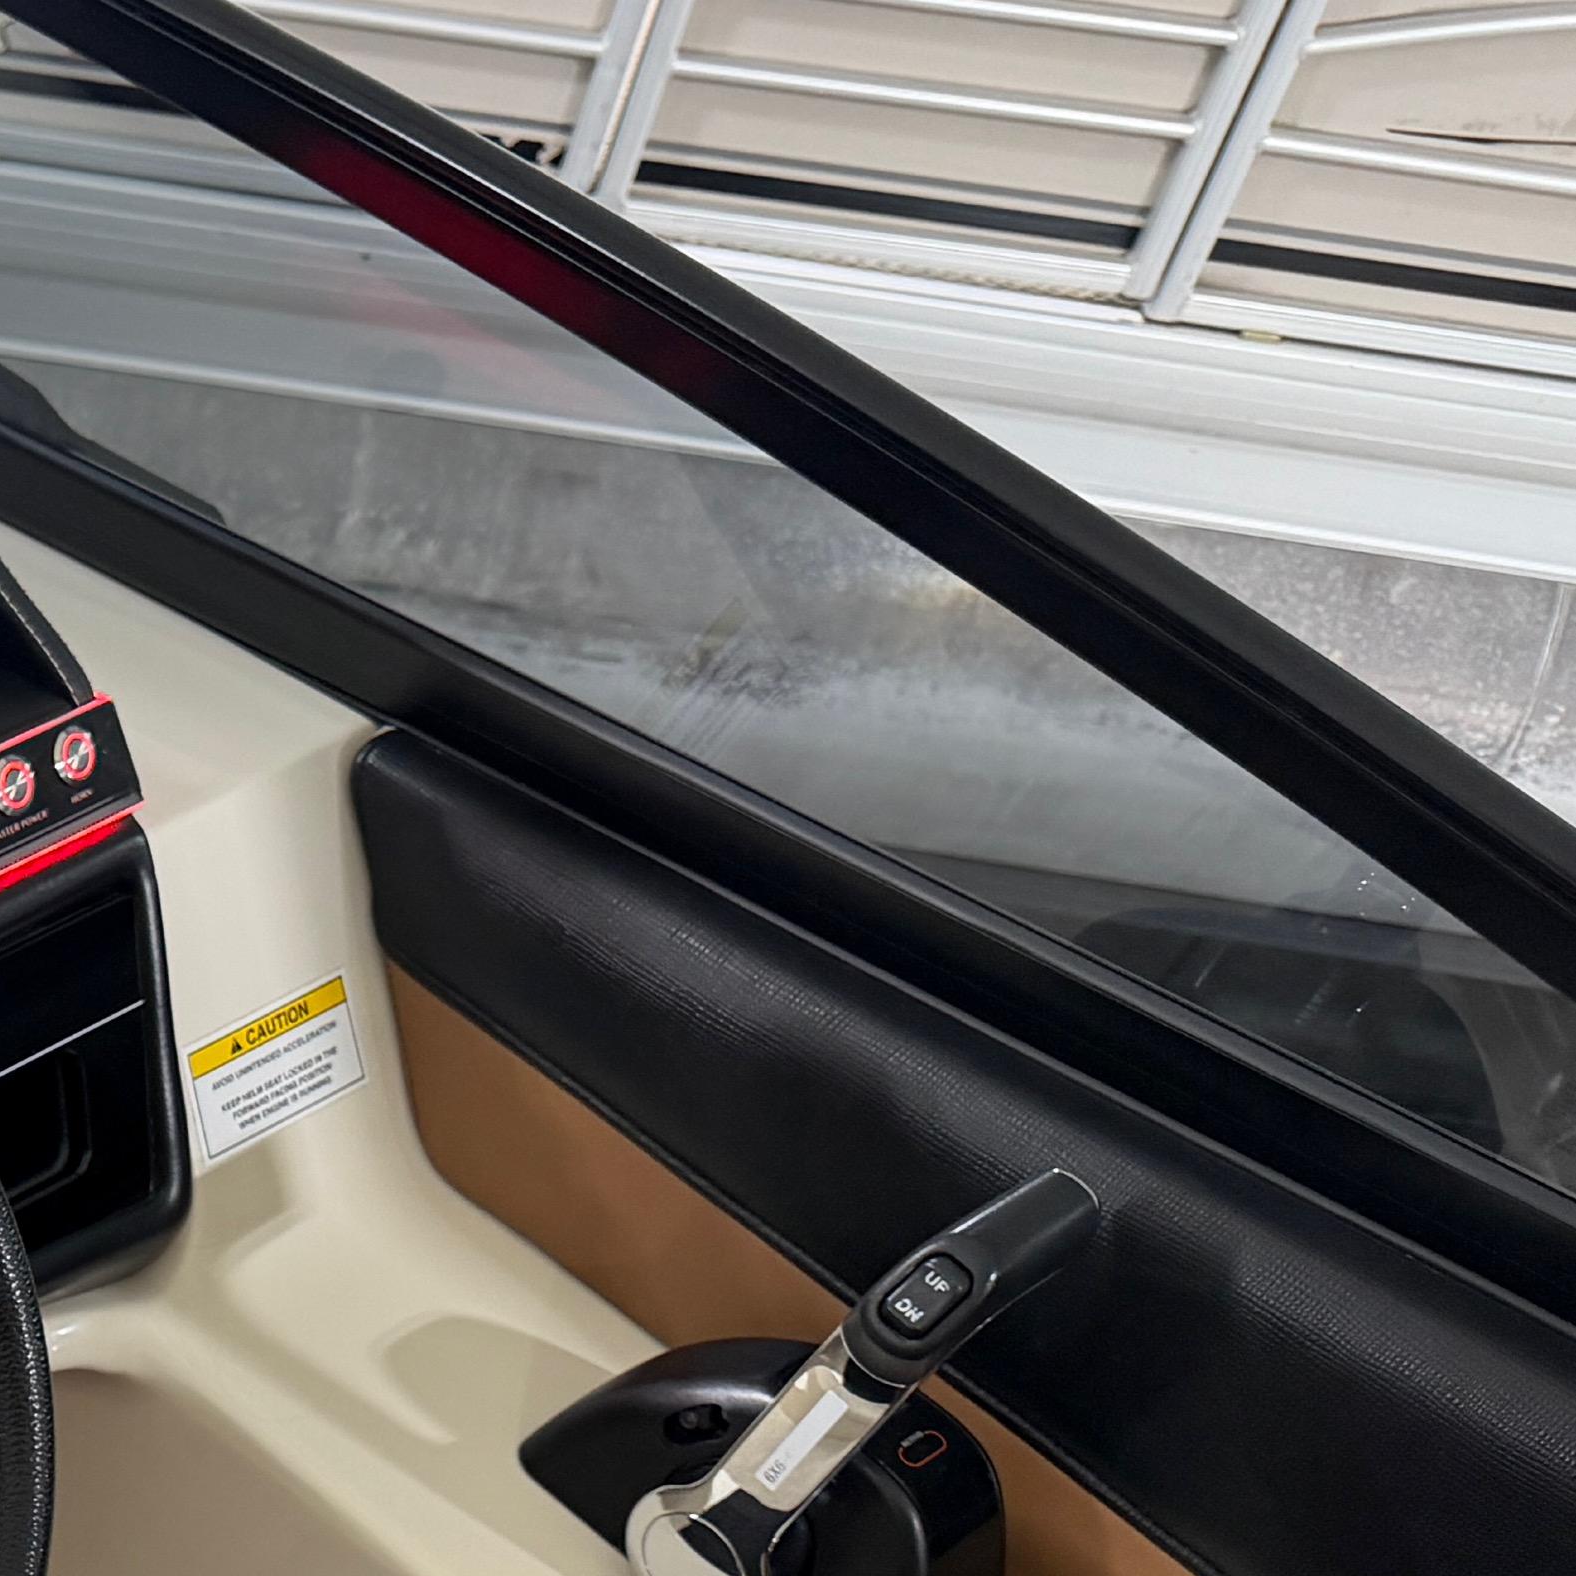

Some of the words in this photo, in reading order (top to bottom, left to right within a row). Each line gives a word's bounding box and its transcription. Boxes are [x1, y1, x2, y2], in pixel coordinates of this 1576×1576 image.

[243, 999, 310, 1047] CAUTION
[234, 1048, 281, 1079] UNINTENDED
[282, 1018, 337, 1054] ACCELERATION
[894, 1298, 924, 1323] DN
